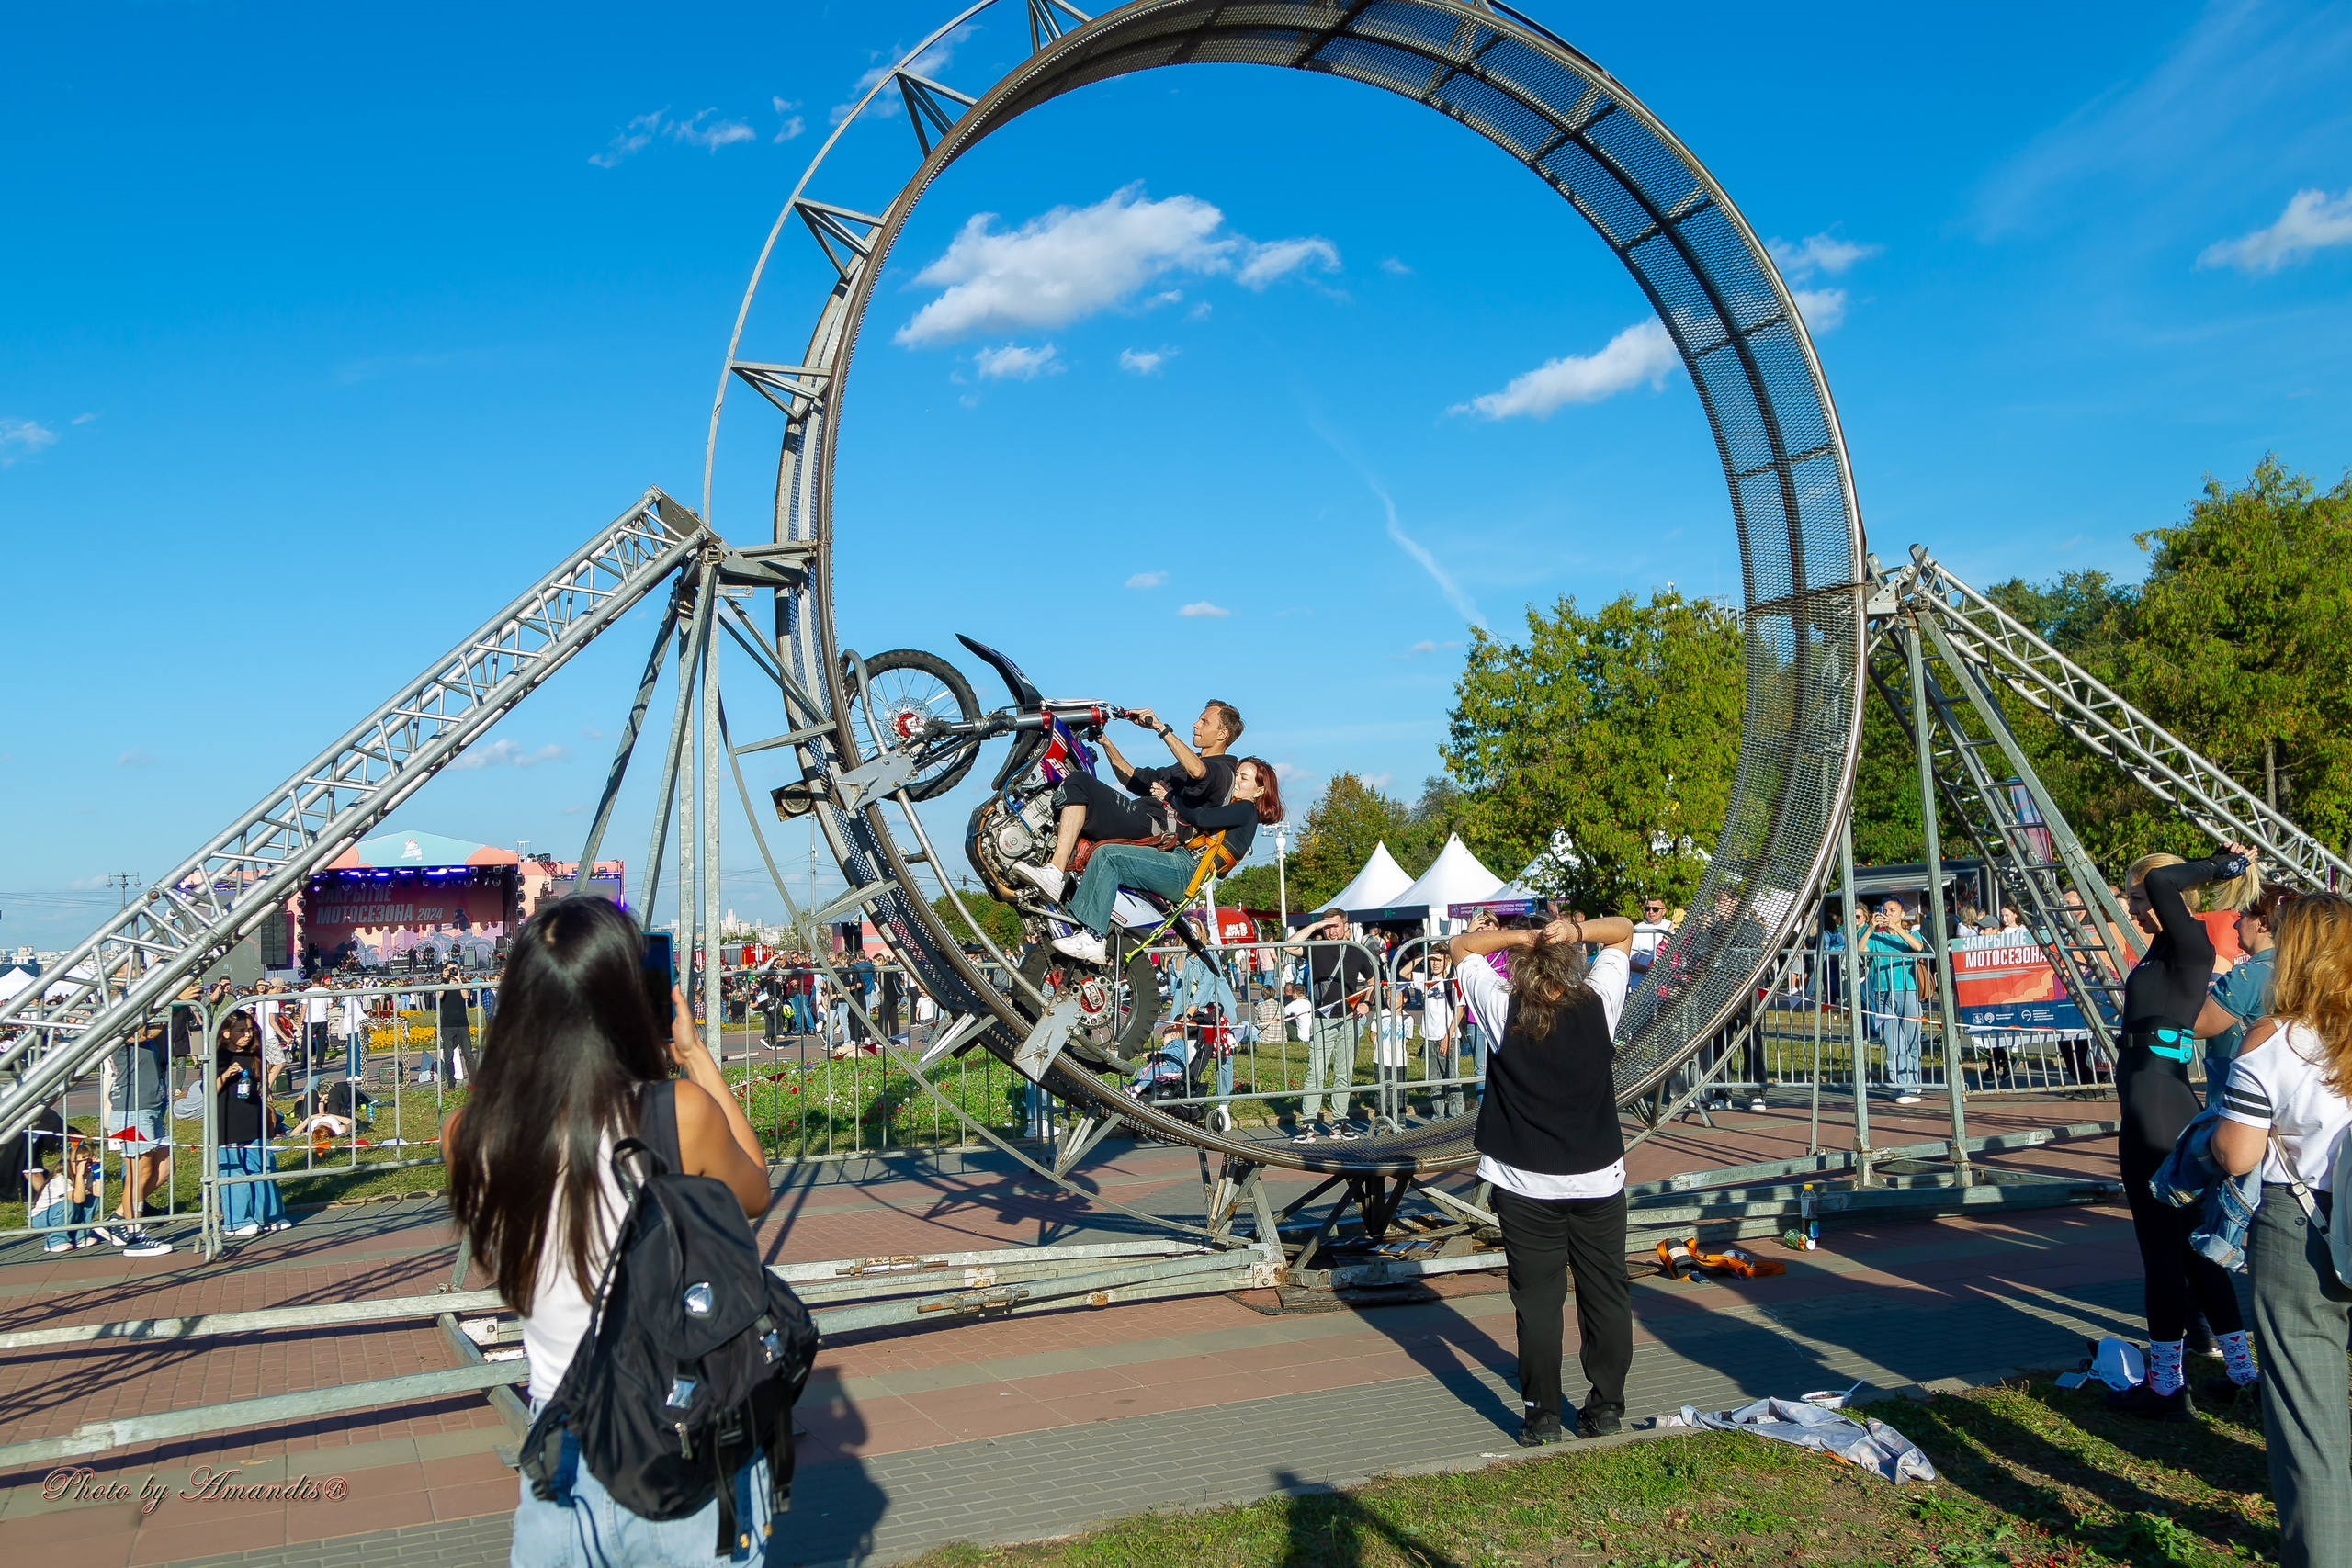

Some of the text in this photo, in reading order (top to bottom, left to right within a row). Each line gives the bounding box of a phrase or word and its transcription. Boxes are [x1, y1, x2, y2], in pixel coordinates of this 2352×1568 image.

[316, 886, 391, 903] ЗАКРЫТИЕ
[316, 904, 443, 923] МОТОСЕЗОНА 2024
[1962, 932, 2027, 950] ЗАКРЫТИЕ
